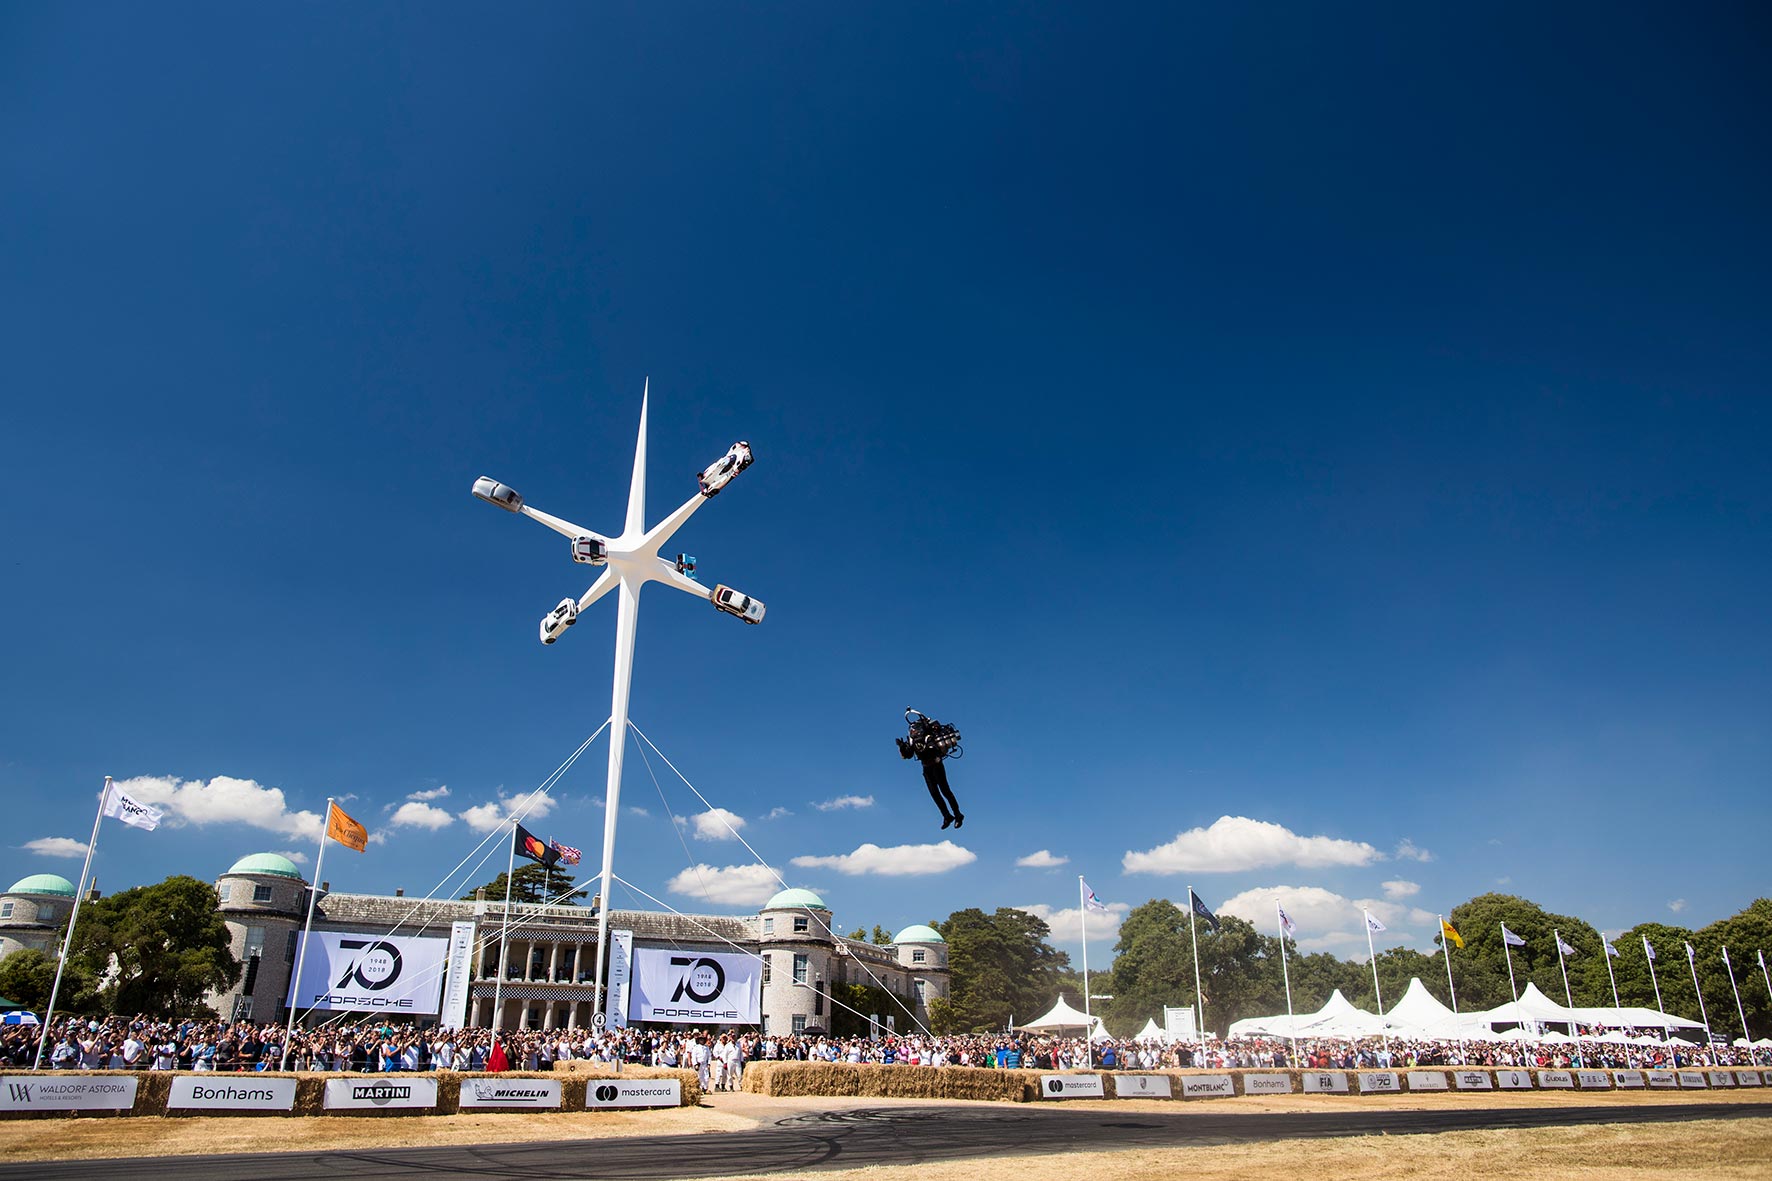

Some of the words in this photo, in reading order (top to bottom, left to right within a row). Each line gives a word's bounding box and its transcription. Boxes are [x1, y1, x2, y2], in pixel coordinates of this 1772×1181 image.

[336, 940, 402, 990] 70
[670, 957, 726, 1004] 70
[314, 995, 413, 1007] PORSCHE
[652, 1008, 738, 1019] PORSCHE
[596, 1015, 602, 1025] 4
[39, 1085, 87, 1094] WALDORF
[88, 1084, 126, 1094] ASTORIA
[1065, 1080, 1097, 1089] mastercard
[1187, 1083, 1225, 1093] MONTBLANC
[1253, 1079, 1285, 1089] Bonhams
[192, 1086, 274, 1101] Bonhams
[354, 1087, 410, 1099] MARTINI
[494, 1089, 550, 1098] MICHELIN
[621, 1087, 671, 1097] mastercard
